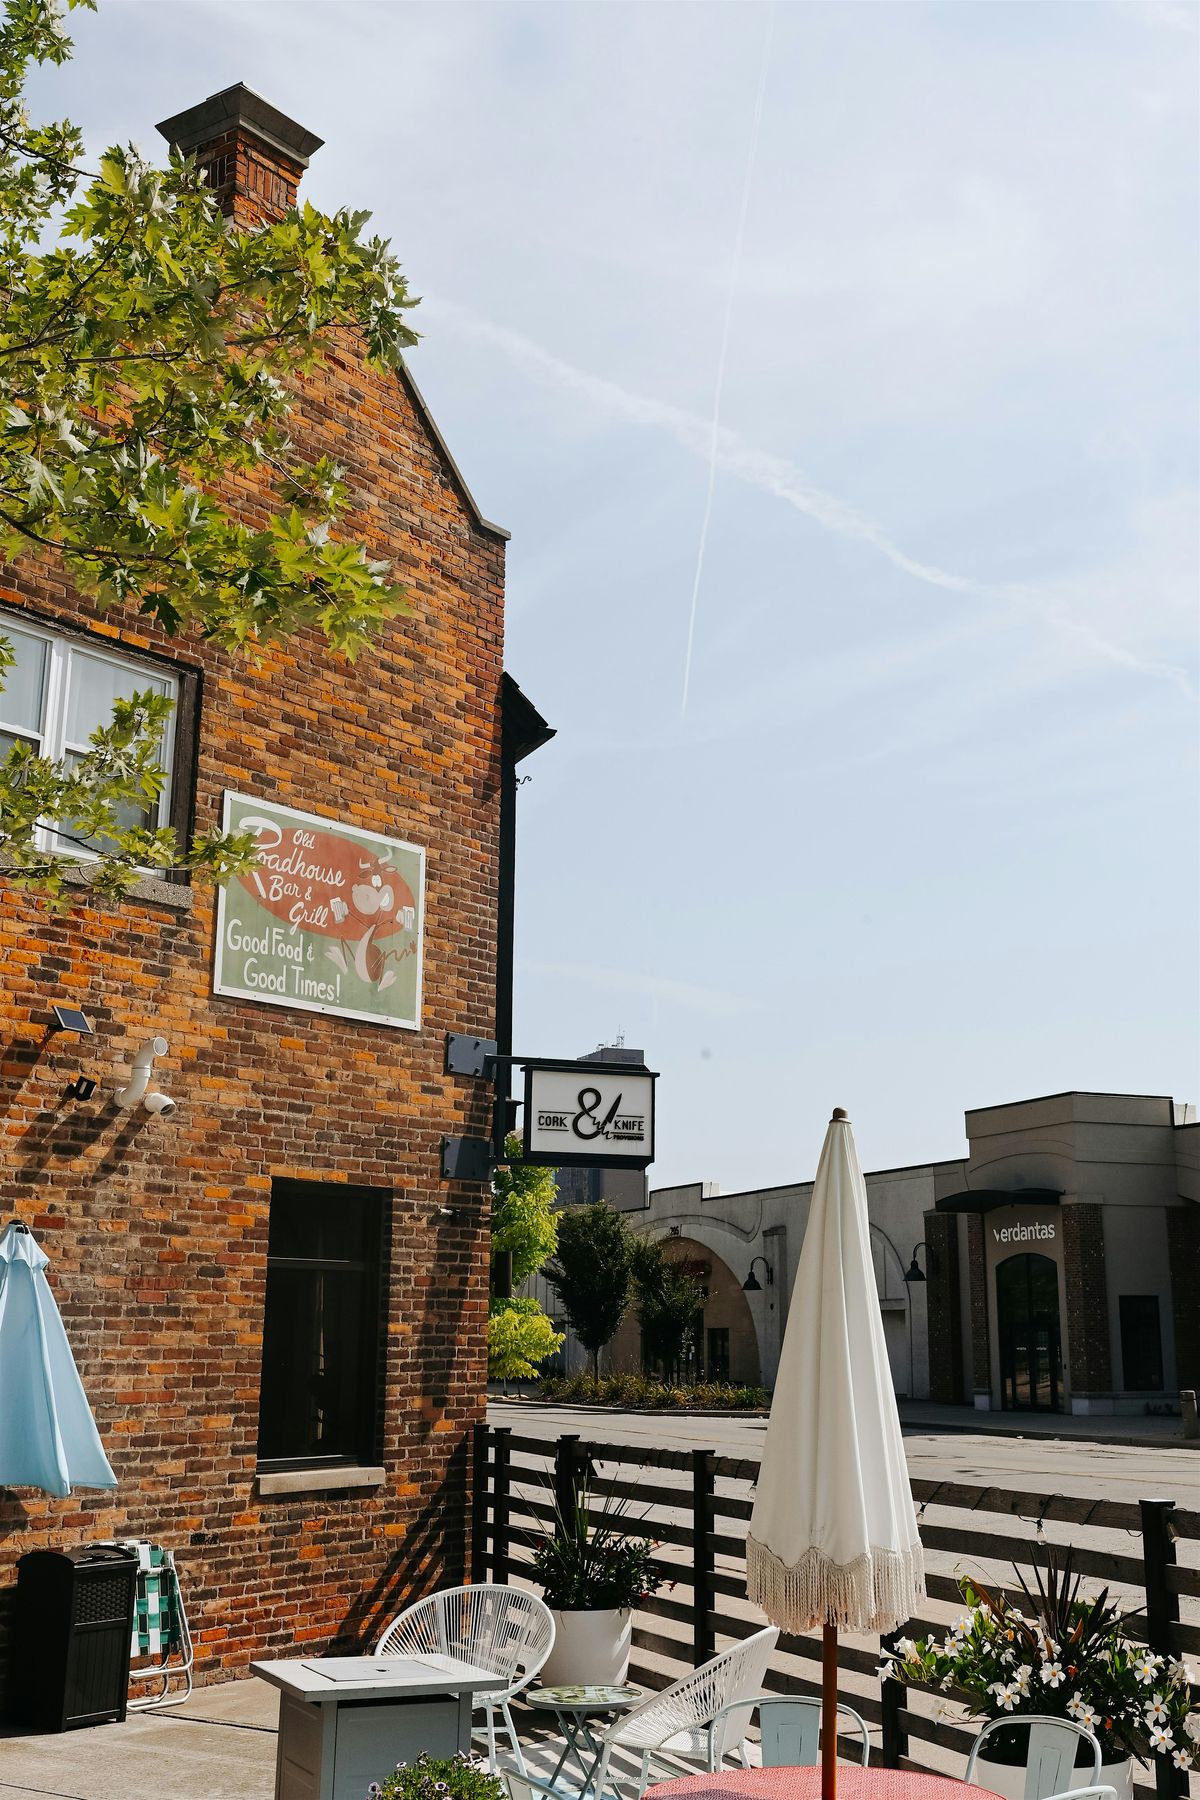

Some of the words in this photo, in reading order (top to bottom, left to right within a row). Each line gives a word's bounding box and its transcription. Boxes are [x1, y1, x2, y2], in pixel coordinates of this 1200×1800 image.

[292, 829, 315, 849] Old
[269, 875, 302, 902] Bar
[304, 886, 313, 901] &
[289, 901, 330, 936] Grill
[226, 918, 269, 956] Good
[272, 927, 304, 963] Food
[306, 943, 315, 962] &
[243, 957, 286, 993] Good
[291, 965, 341, 1004] Times!
[538, 1115, 568, 1128] CORK
[614, 1120, 645, 1132] KNIFE
[992, 1221, 1056, 1243] verdantas
